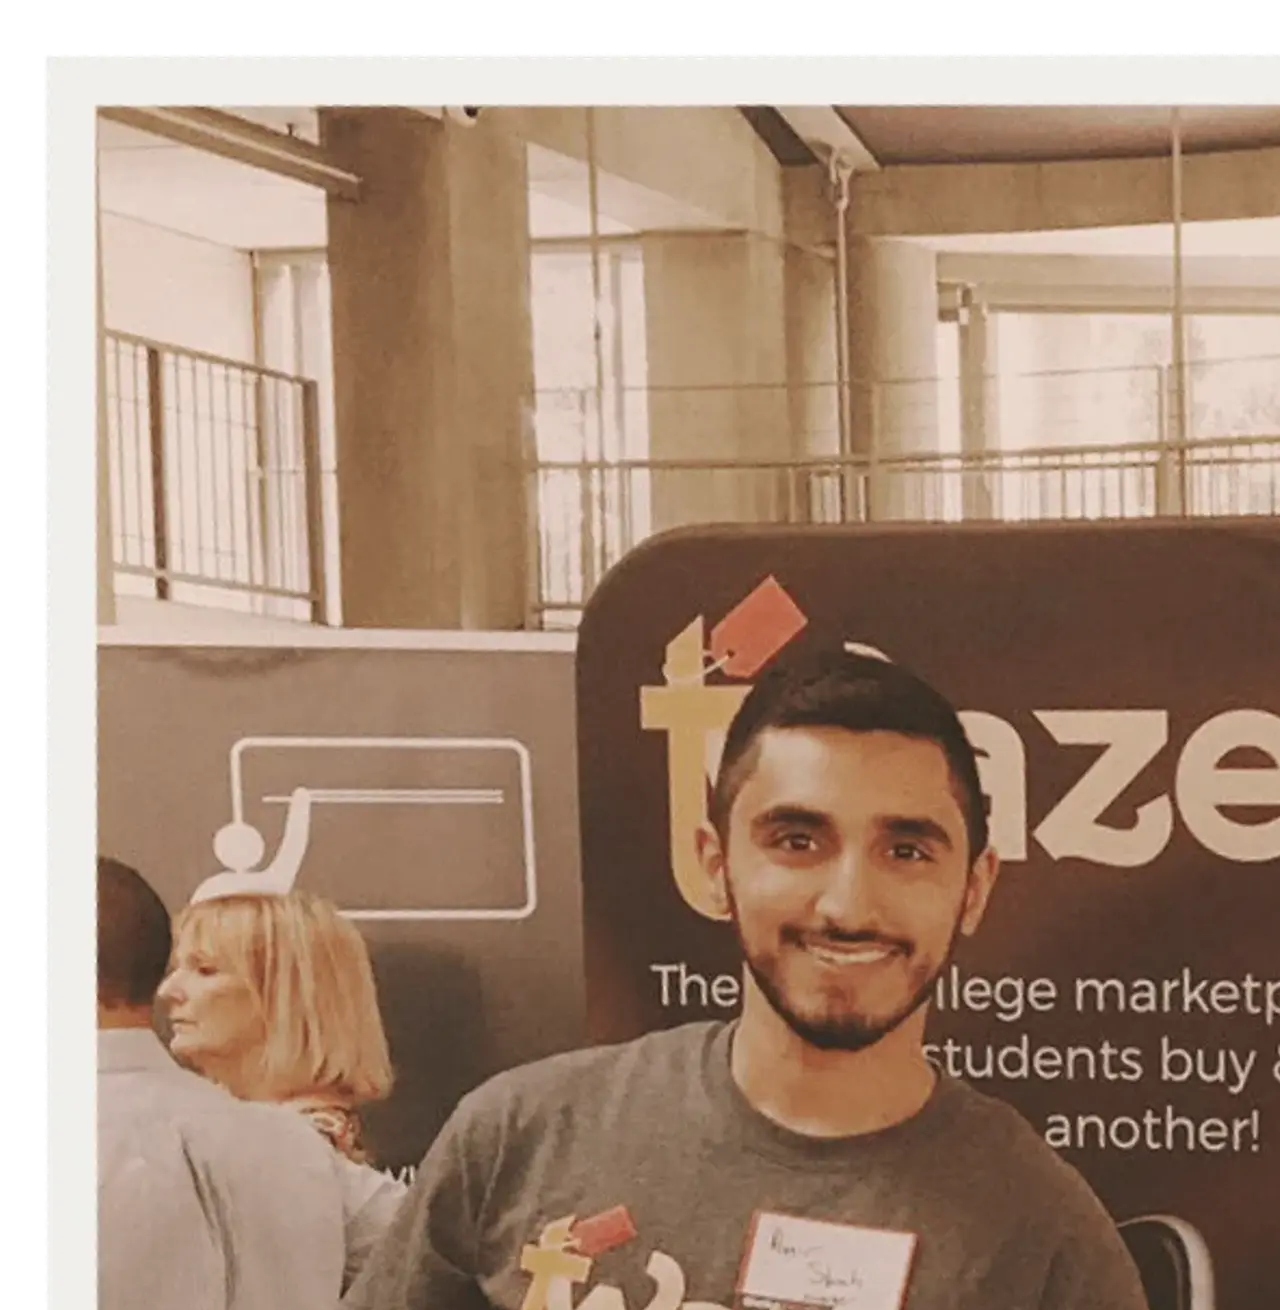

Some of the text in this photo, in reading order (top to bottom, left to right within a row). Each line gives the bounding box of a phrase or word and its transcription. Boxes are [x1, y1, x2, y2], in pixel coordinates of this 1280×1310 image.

[650, 962, 740, 1007] The
[936, 966, 1057, 1022] llege
[1160, 1039, 1255, 1090] buy
[1044, 1110, 1261, 1154] another!
